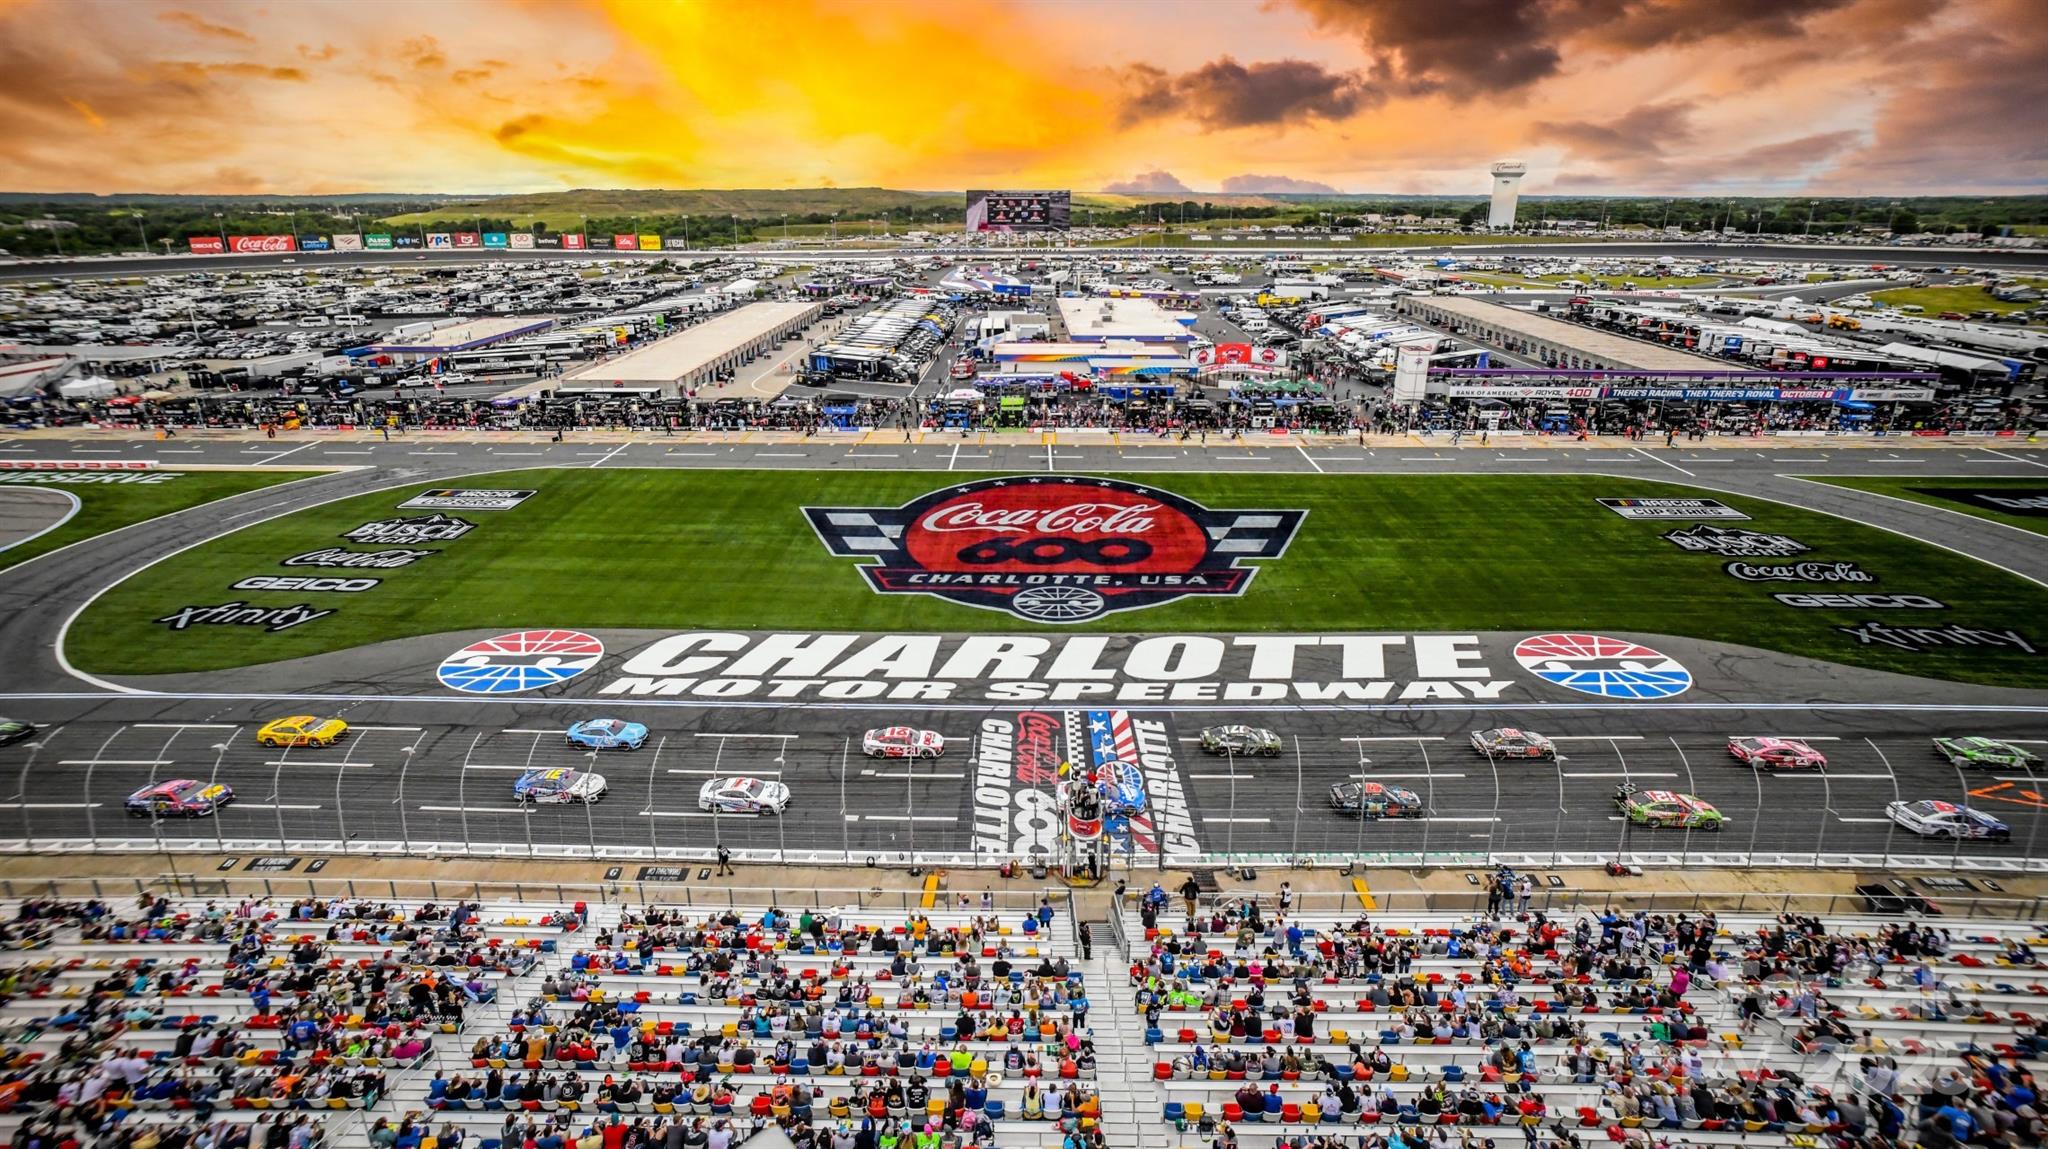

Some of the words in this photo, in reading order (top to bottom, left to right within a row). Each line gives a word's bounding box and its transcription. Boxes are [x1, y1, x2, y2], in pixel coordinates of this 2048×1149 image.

[237, 236, 289, 251] Coca-Cola
[1566, 388, 1592, 397] 400
[1613, 389, 1647, 397] THERE'S
[1686, 389, 1708, 397] THEN
[1710, 389, 1743, 398] THERE'S
[1780, 391, 1823, 399] OCTOBER
[922, 502, 1163, 533] Coca-Cola
[1631, 508, 1664, 516] CUP
[1667, 508, 1723, 516] SERIES
[359, 521, 474, 540] BUSCH
[957, 537, 1153, 565] 600
[1668, 532, 1810, 552] BUSCH
[284, 548, 436, 568] Coca-Cola
[1718, 547, 1796, 557] LIGHT
[908, 572, 1124, 587] CHARLOTTE,
[1141, 574, 1208, 586] USA
[1727, 561, 1873, 583] Coca-Cola
[232, 576, 380, 591] GEICO
[1773, 593, 1946, 609] GEICO
[163, 602, 332, 632] xfinity
[1840, 621, 2036, 654] xfinity
[621, 633, 1491, 680] CHARLOTTE
[598, 679, 958, 699] MOTOR
[985, 680, 1515, 701] SPEEDWAY
[1132, 718, 1201, 855] CHARLOTTE
[700, 870, 709, 878] F
